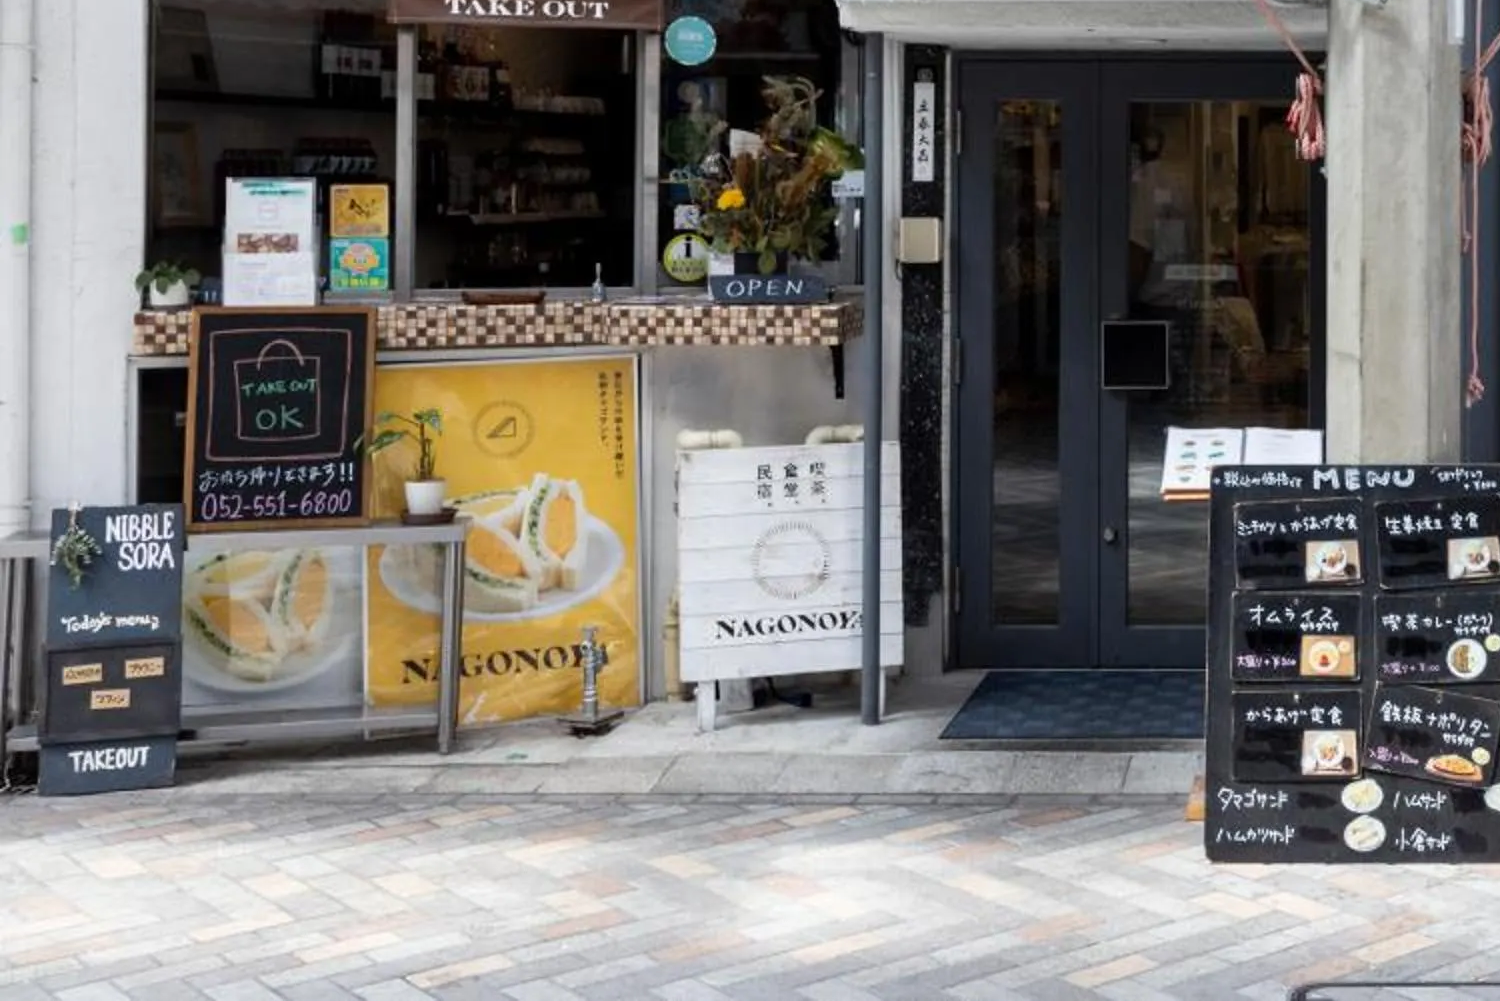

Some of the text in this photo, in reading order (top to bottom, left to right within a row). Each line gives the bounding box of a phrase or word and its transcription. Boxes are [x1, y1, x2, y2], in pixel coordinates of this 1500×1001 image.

[541, 0, 610, 20] OUT
[725, 278, 804, 299] OPEN
[241, 378, 318, 397] TAKE OUT
[255, 404, 305, 430] OK
[1312, 467, 1416, 490] MENU
[201, 489, 352, 520] 052-551-6800
[105, 511, 176, 543] NIBBLE
[117, 542, 176, 571] SORA
[401, 644, 608, 684] NGONO
[68, 746, 151, 773] TAKEOUT
